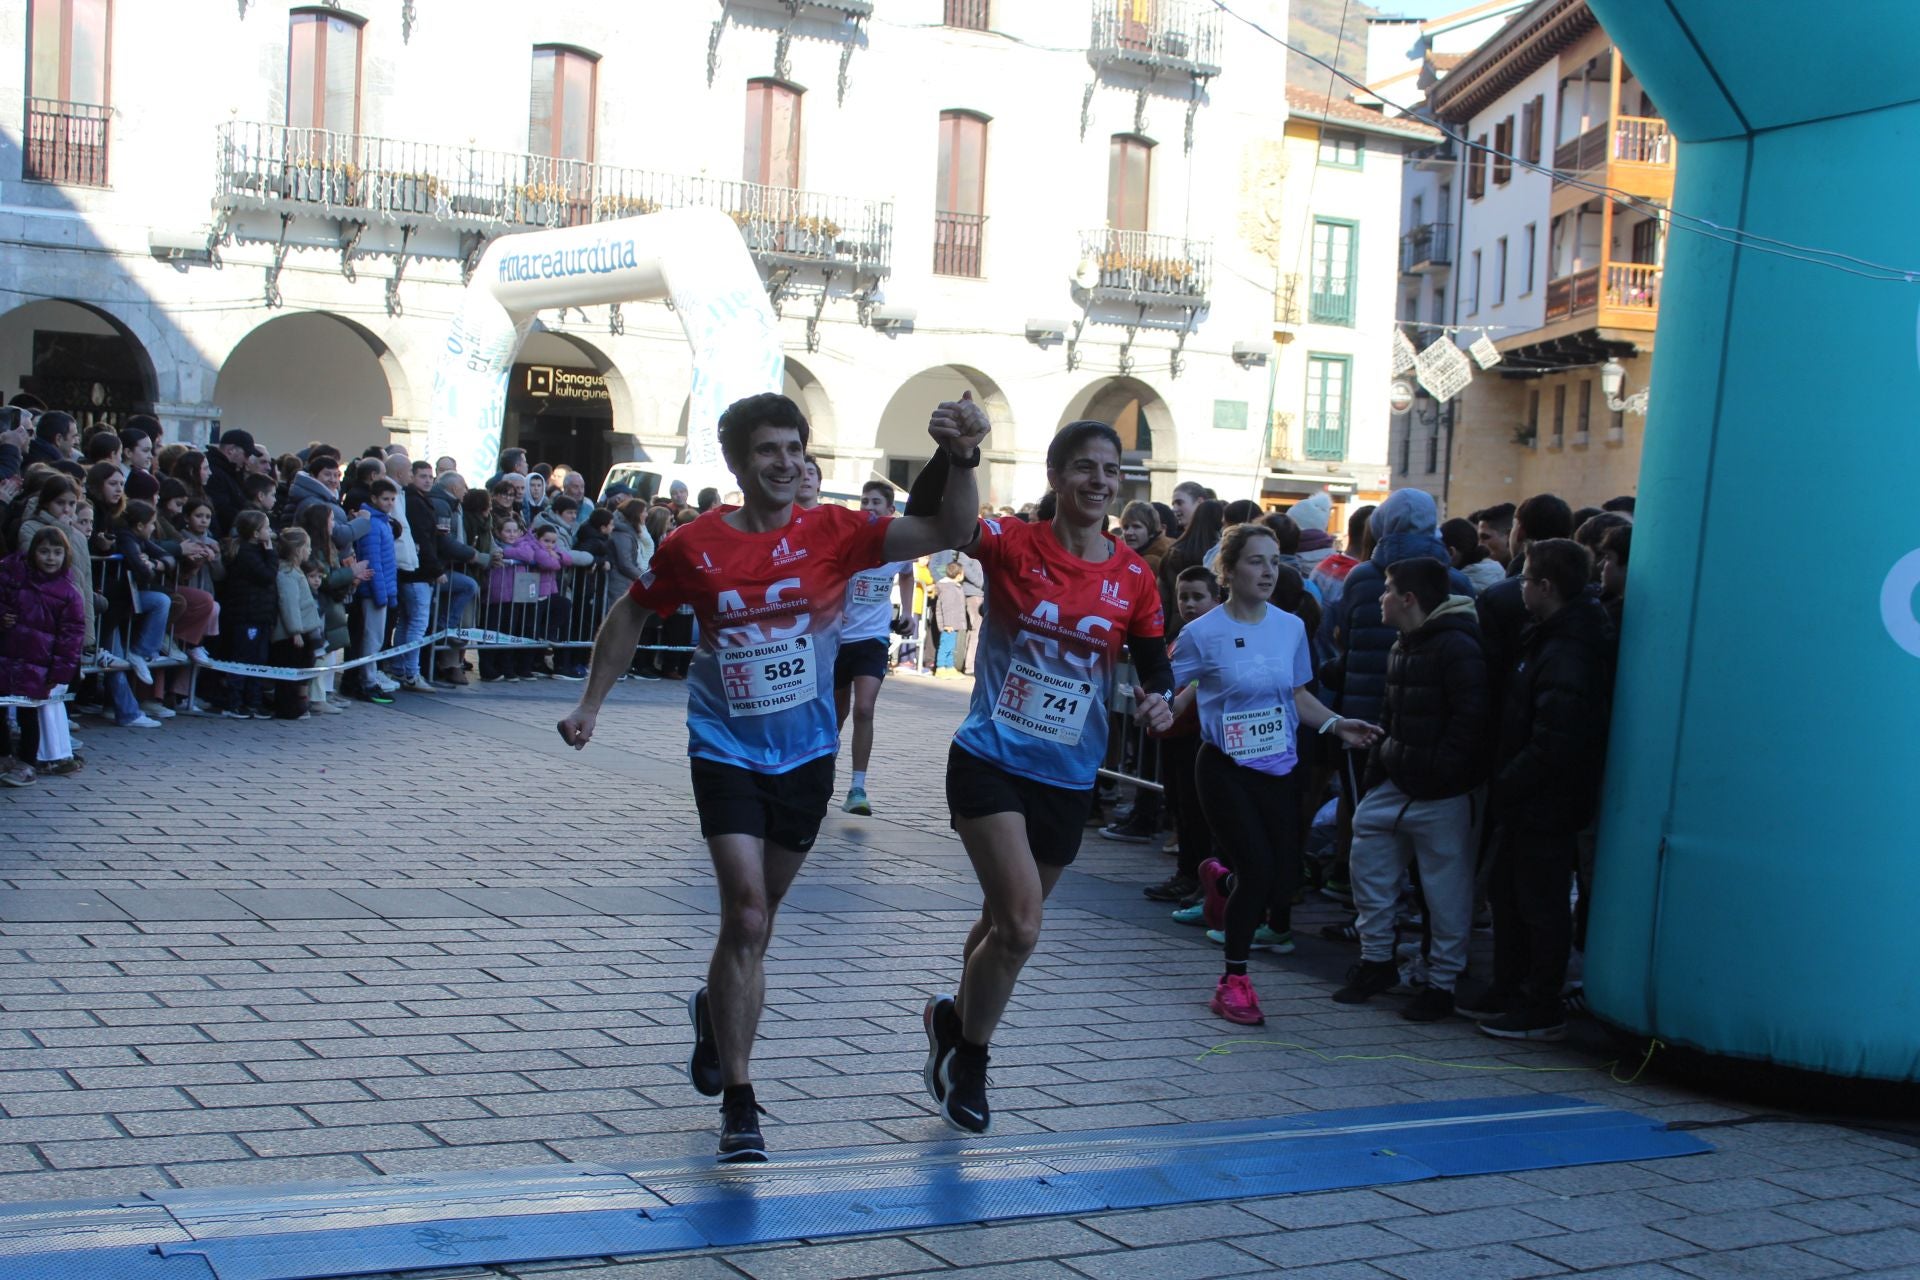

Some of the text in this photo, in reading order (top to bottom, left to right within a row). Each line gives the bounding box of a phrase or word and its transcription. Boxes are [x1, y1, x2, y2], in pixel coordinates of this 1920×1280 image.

[499, 238, 637, 283] #mareaurdina
[555, 384, 610, 401] kulturgune
[749, 597, 808, 616] Sansilbestrie
[1017, 612, 1108, 648] Azpeitiko Sansilbestrie
[725, 643, 788, 661] ONDO BUKAU
[764, 658, 806, 681] 582
[1015, 664, 1074, 690] ONDO BUKAU
[772, 679, 802, 691] GOTZON
[732, 699, 770, 711] HOBETO
[772, 692, 796, 706] HASI!
[1042, 693, 1078, 715] 741
[997, 708, 1034, 728] HOBETO
[1034, 722, 1058, 736] HASI!
[1045, 713, 1066, 724] MAITE
[1226, 713, 1247, 722] ONDO
[1249, 720, 1283, 736] 1093
